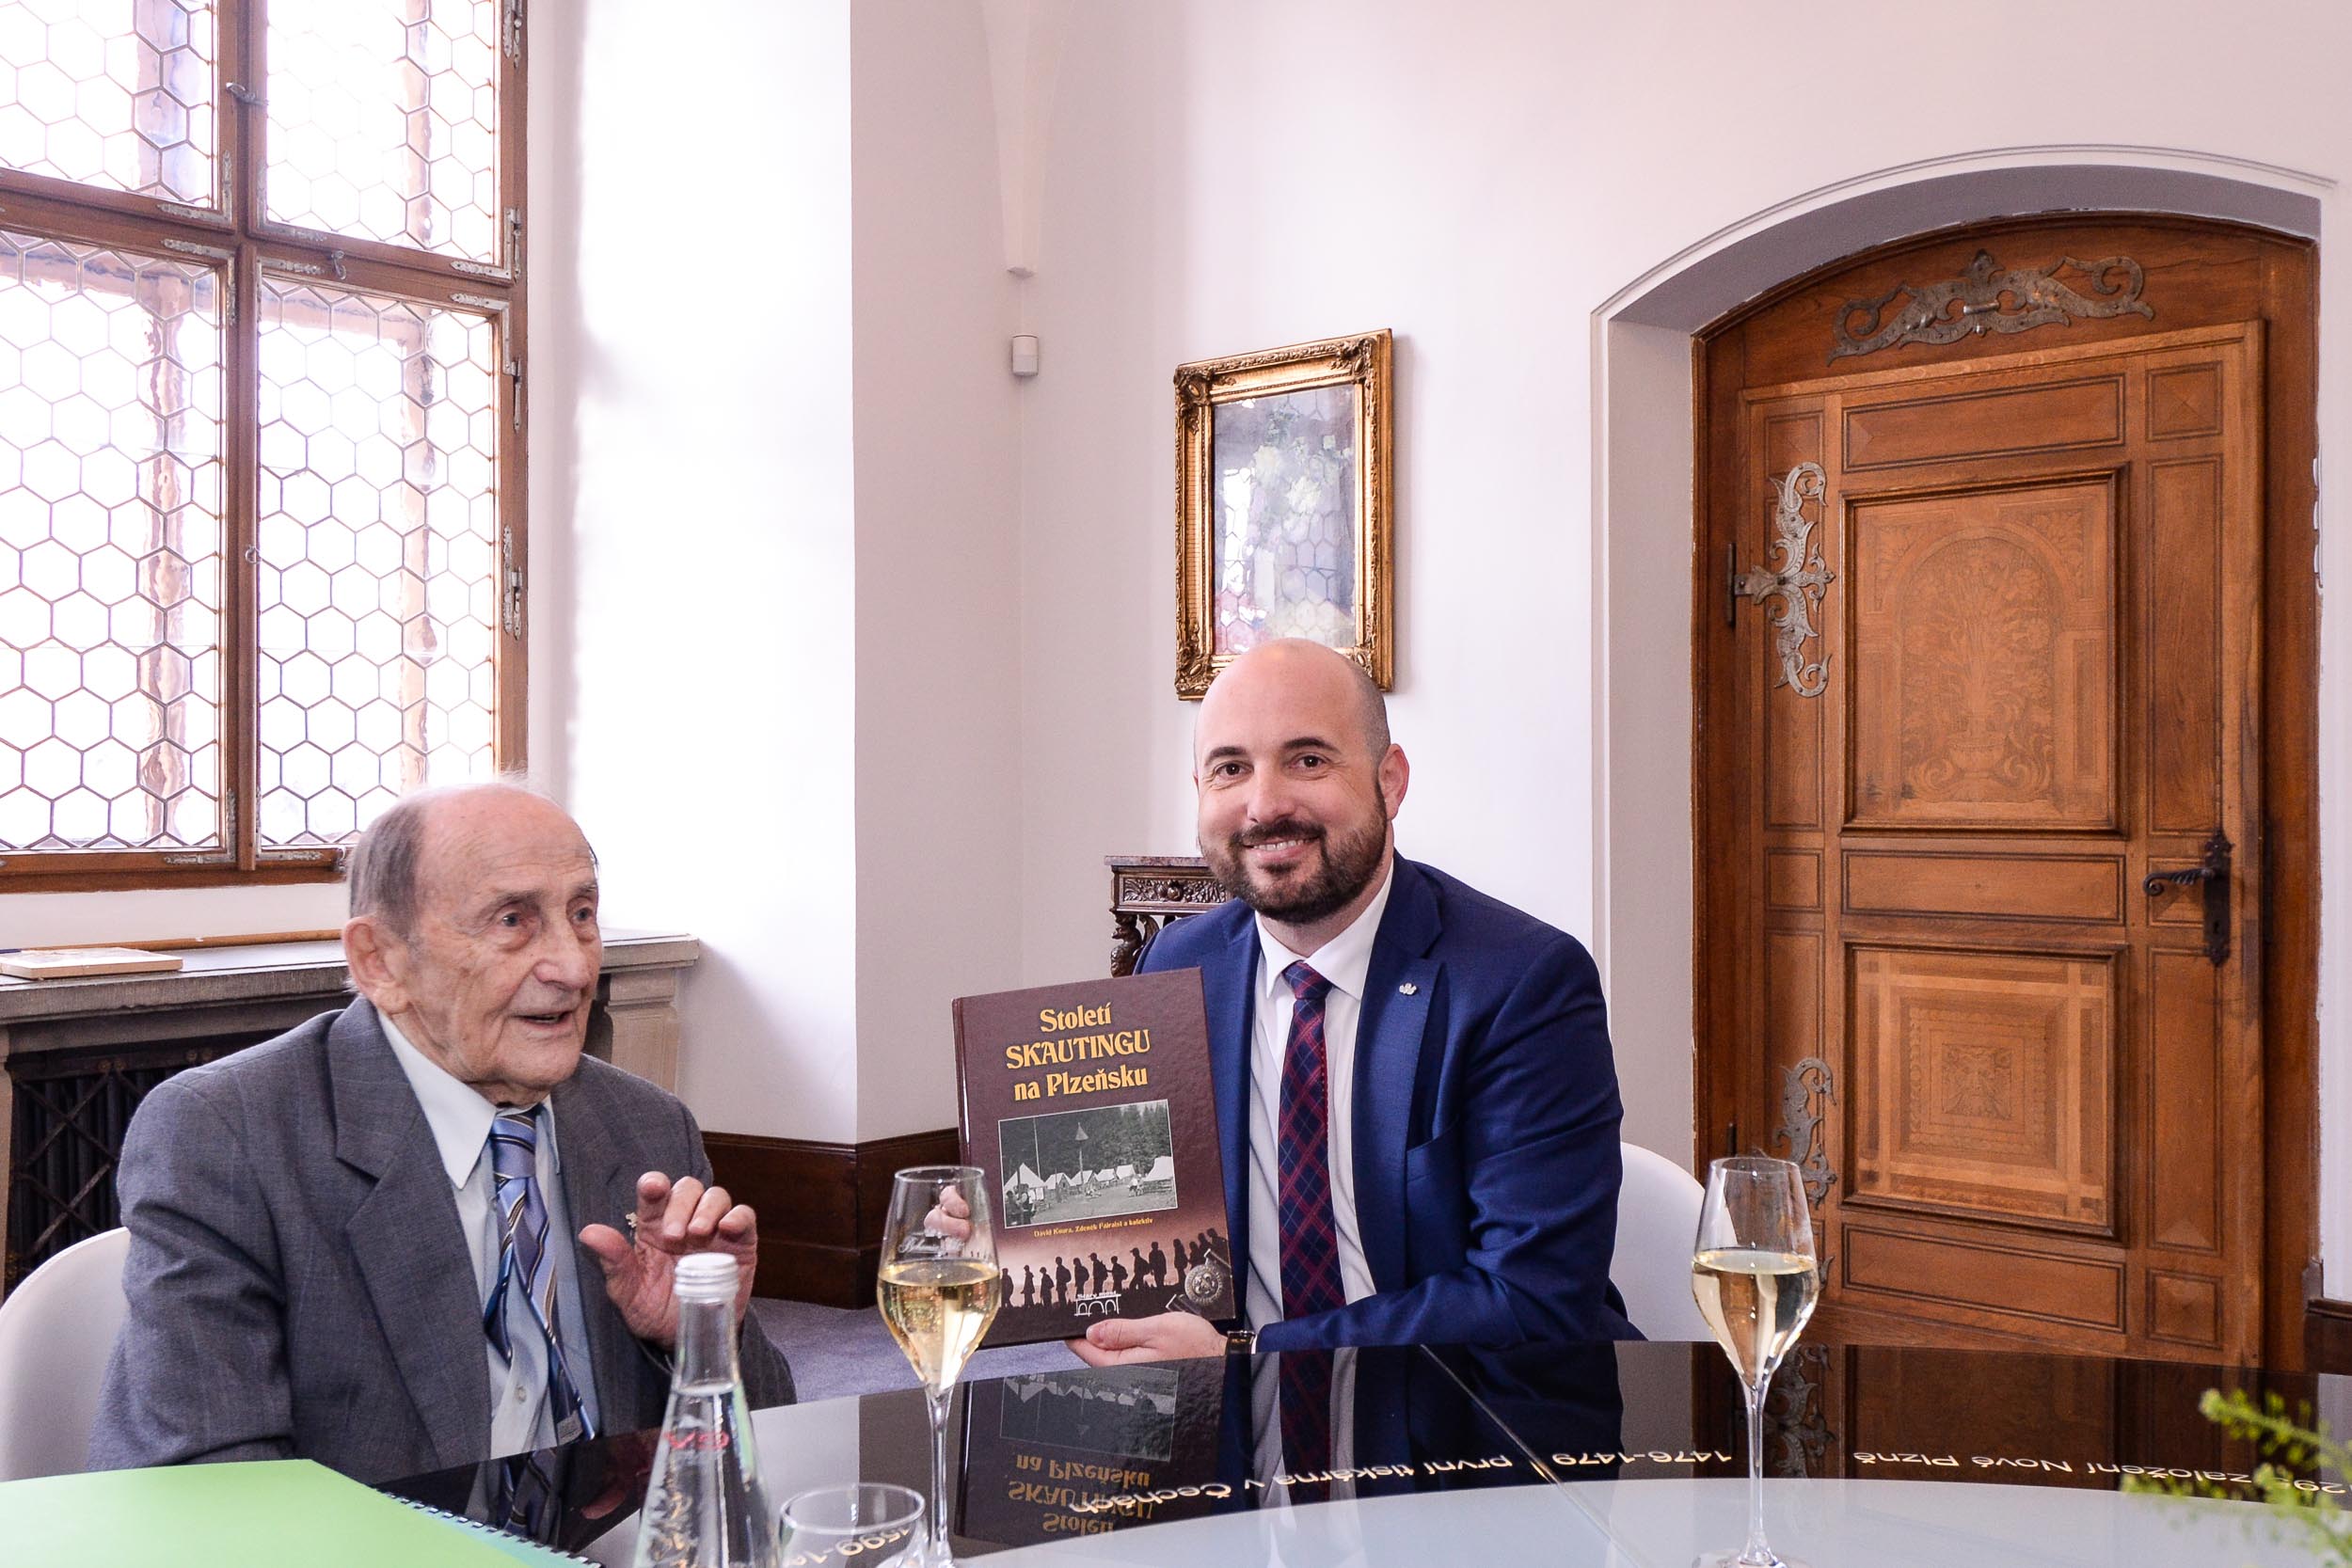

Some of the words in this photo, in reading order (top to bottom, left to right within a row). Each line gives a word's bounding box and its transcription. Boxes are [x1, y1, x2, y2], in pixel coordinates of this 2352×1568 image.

[1040, 1002, 1112, 1032] Století
[1006, 1029, 1151, 1069] SKAUTINGU
[1014, 1082, 1041, 1101] na
[1046, 1065, 1148, 1098] Plzeňsku
[1034, 1228, 1052, 1237] David
[1129, 1217, 1153, 1226] kolektiv
[1422, 1454, 1514, 1476] první
[1552, 1449, 1732, 1465] 1476-1479
[1852, 1451, 1961, 1467] Plzně
[1972, 1455, 2074, 1472] Nové
[1243, 1478, 1264, 1490] v
[1273, 1464, 1415, 1488] tiskárna
[2086, 1462, 2252, 1484] založení
[2272, 1477, 2352, 1494] 29
[1067, 1482, 1232, 1515] Čechách
